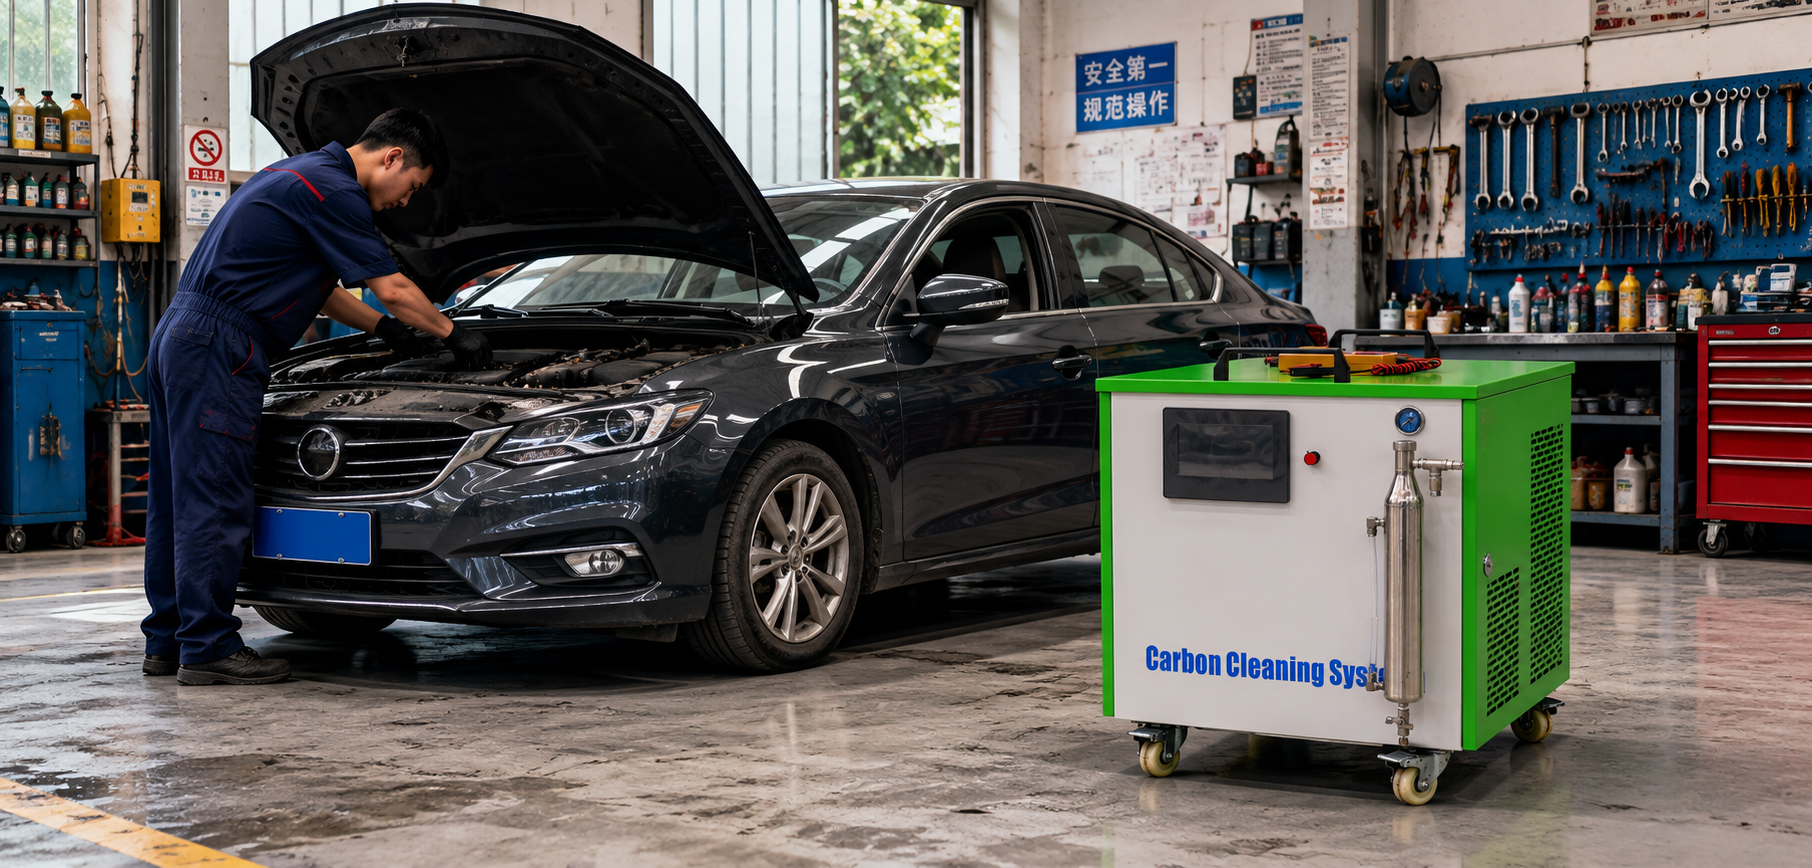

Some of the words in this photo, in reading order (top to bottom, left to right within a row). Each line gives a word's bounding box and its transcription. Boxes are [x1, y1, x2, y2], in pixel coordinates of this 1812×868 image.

[1084, 55, 1168, 87] 安全第一
[1084, 90, 1169, 122] 规范操作
[1145, 645, 1222, 676] Carbon
[1226, 651, 1325, 688] Cleaning
[1329, 659, 1425, 691] Sys
